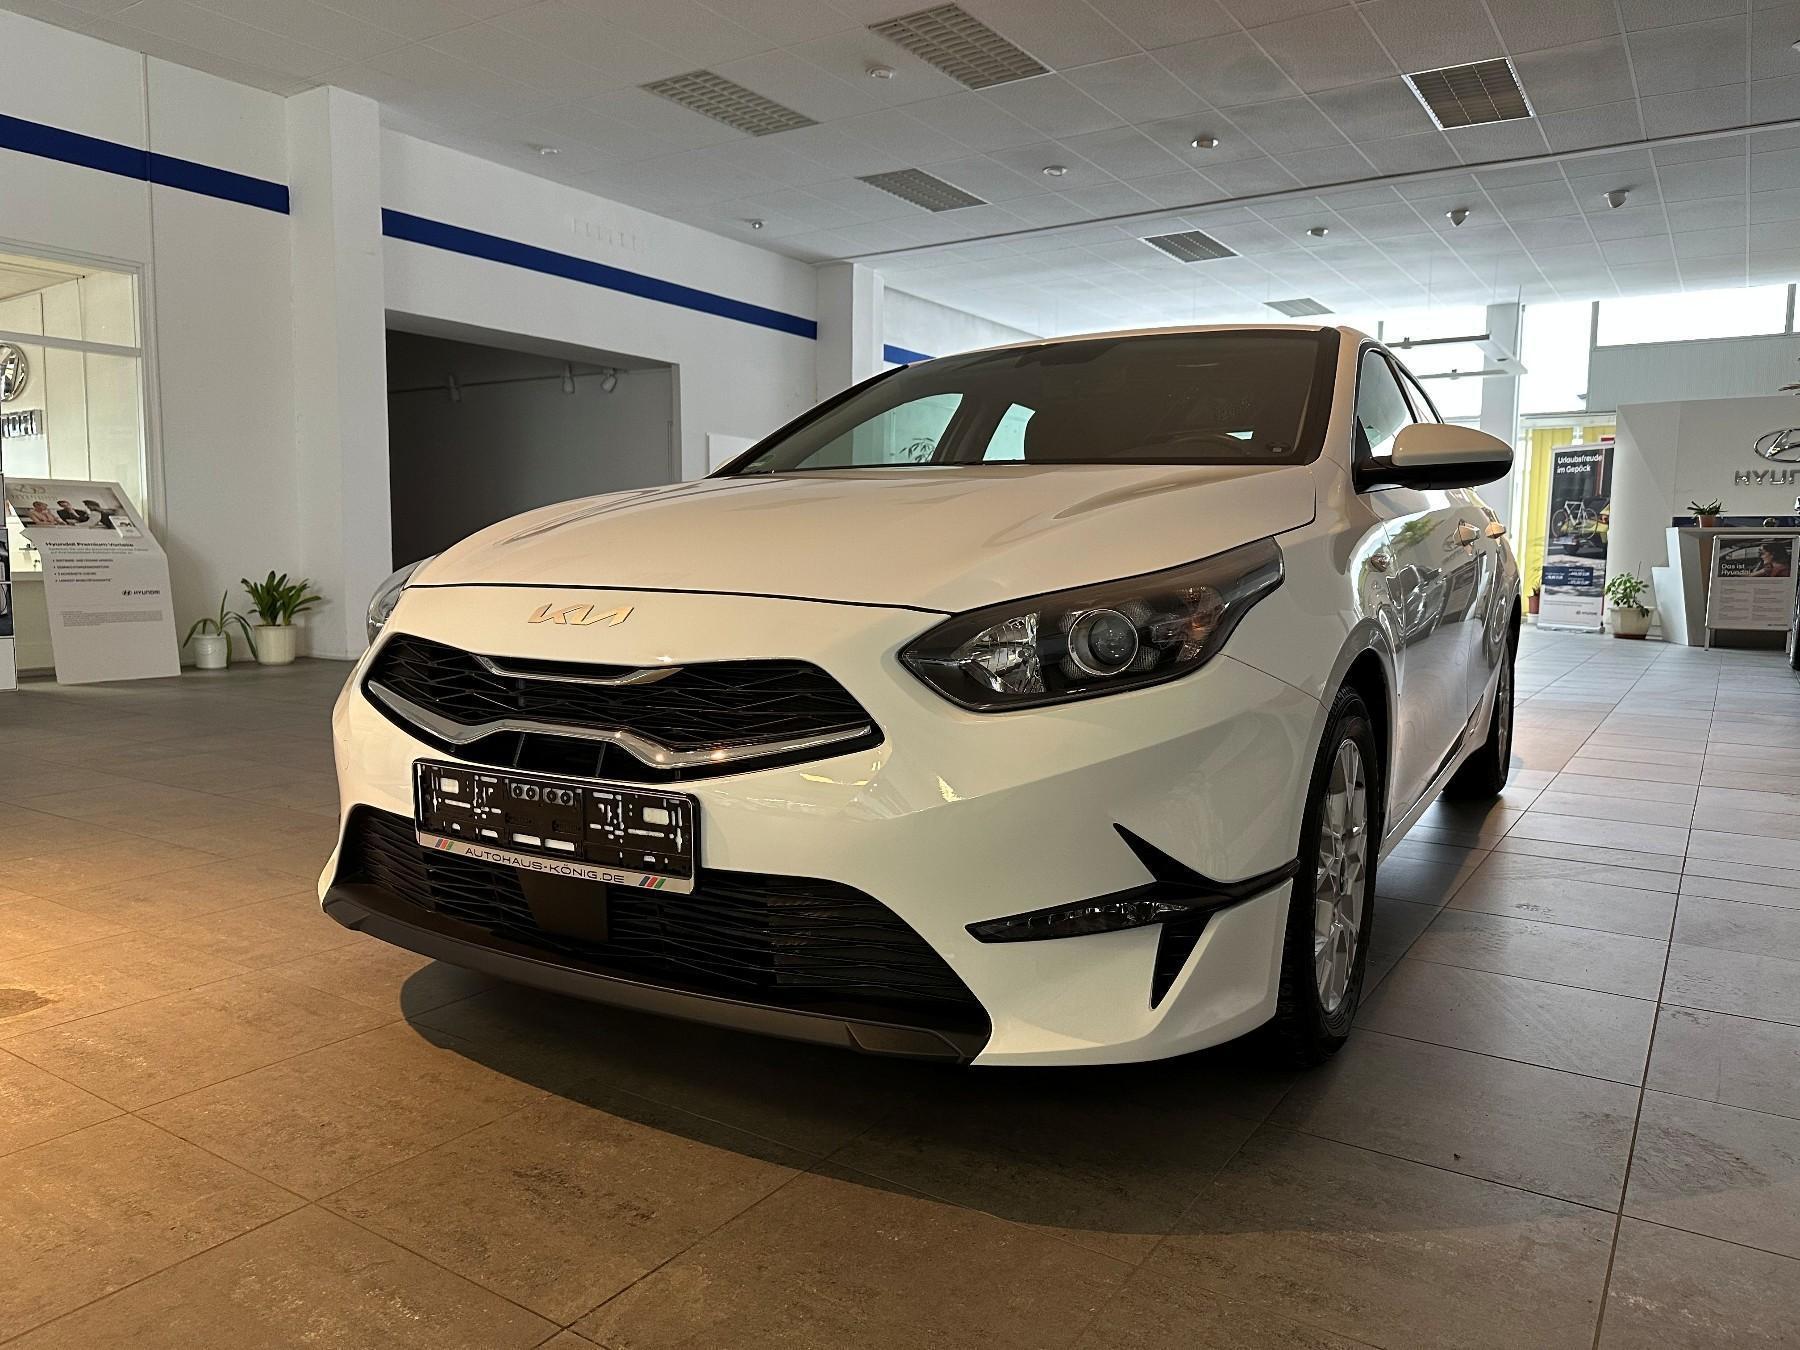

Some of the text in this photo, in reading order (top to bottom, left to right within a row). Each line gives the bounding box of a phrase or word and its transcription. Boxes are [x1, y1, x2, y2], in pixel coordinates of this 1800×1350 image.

[1557, 454, 1603, 464] Urlaubsfreude
[1556, 466, 1566, 474] im
[527, 603, 635, 627] KIA
[465, 847, 625, 883] AUTOHAUS-KÖNIG.DE
